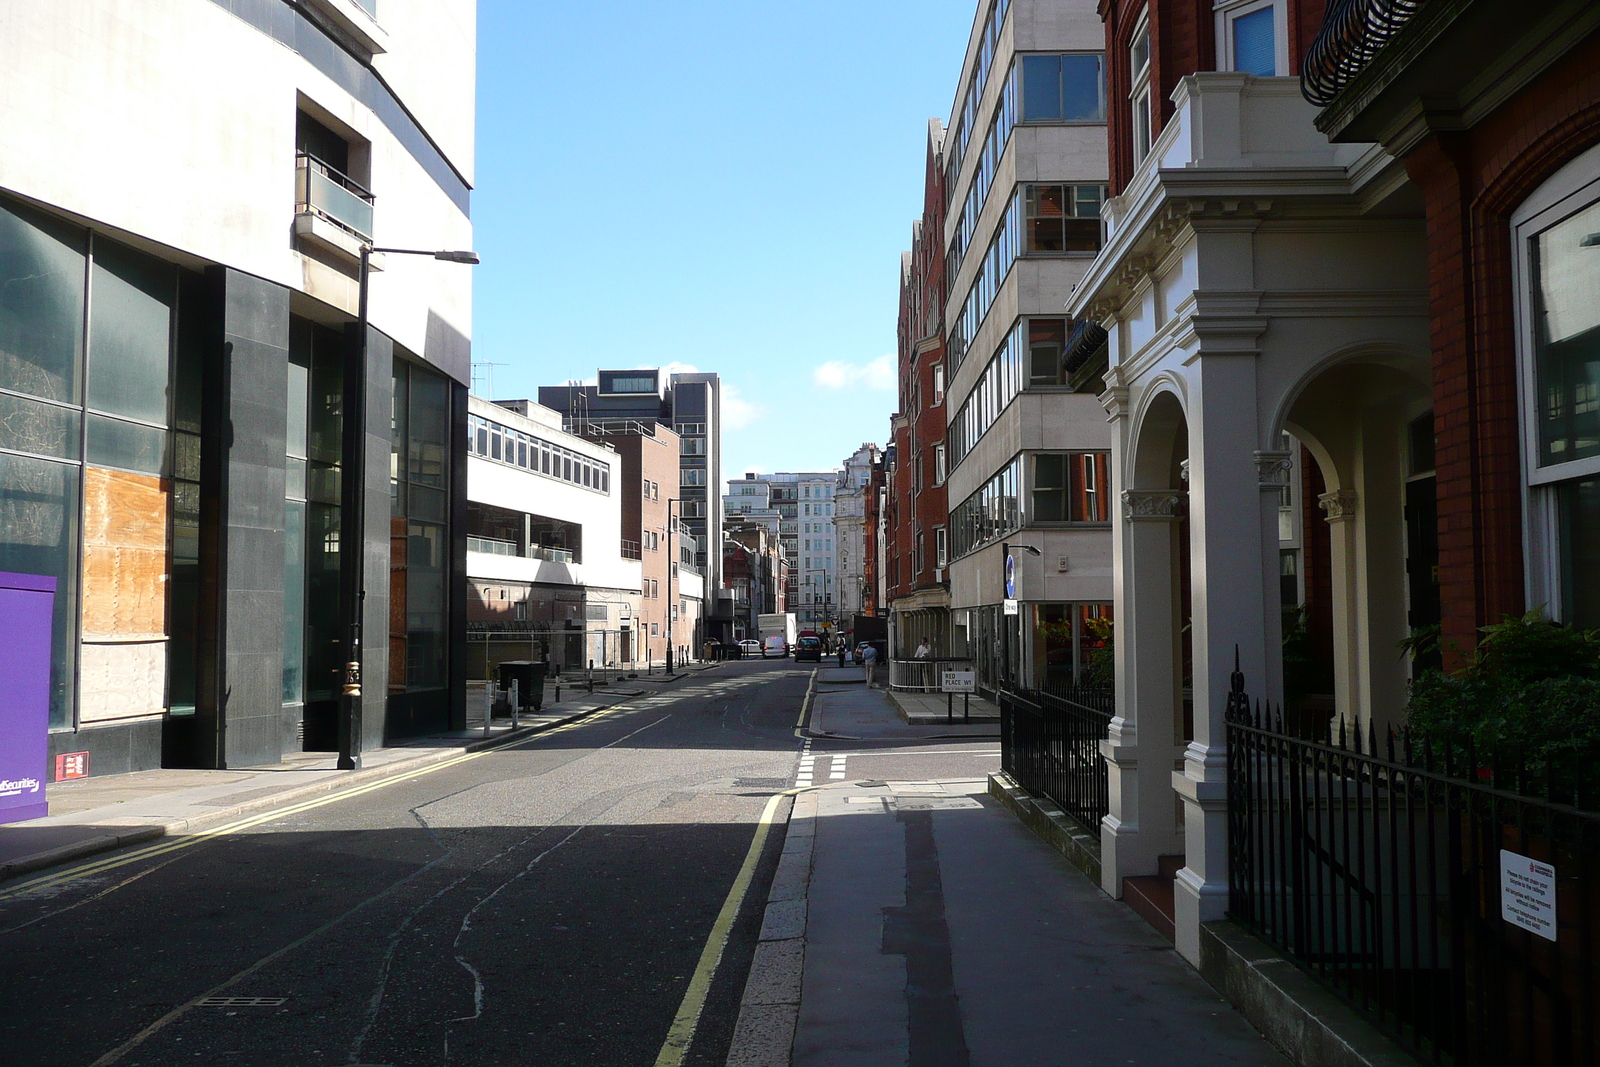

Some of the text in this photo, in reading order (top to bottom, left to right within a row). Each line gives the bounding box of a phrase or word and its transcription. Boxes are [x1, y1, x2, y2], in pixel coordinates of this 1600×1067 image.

[1506, 869, 1517, 878] Please
[1516, 899, 1540, 912] without notice
[1535, 899, 1551, 910] removed
[1507, 904, 1519, 914] Contact
[1520, 910, 1536, 921] telephone
